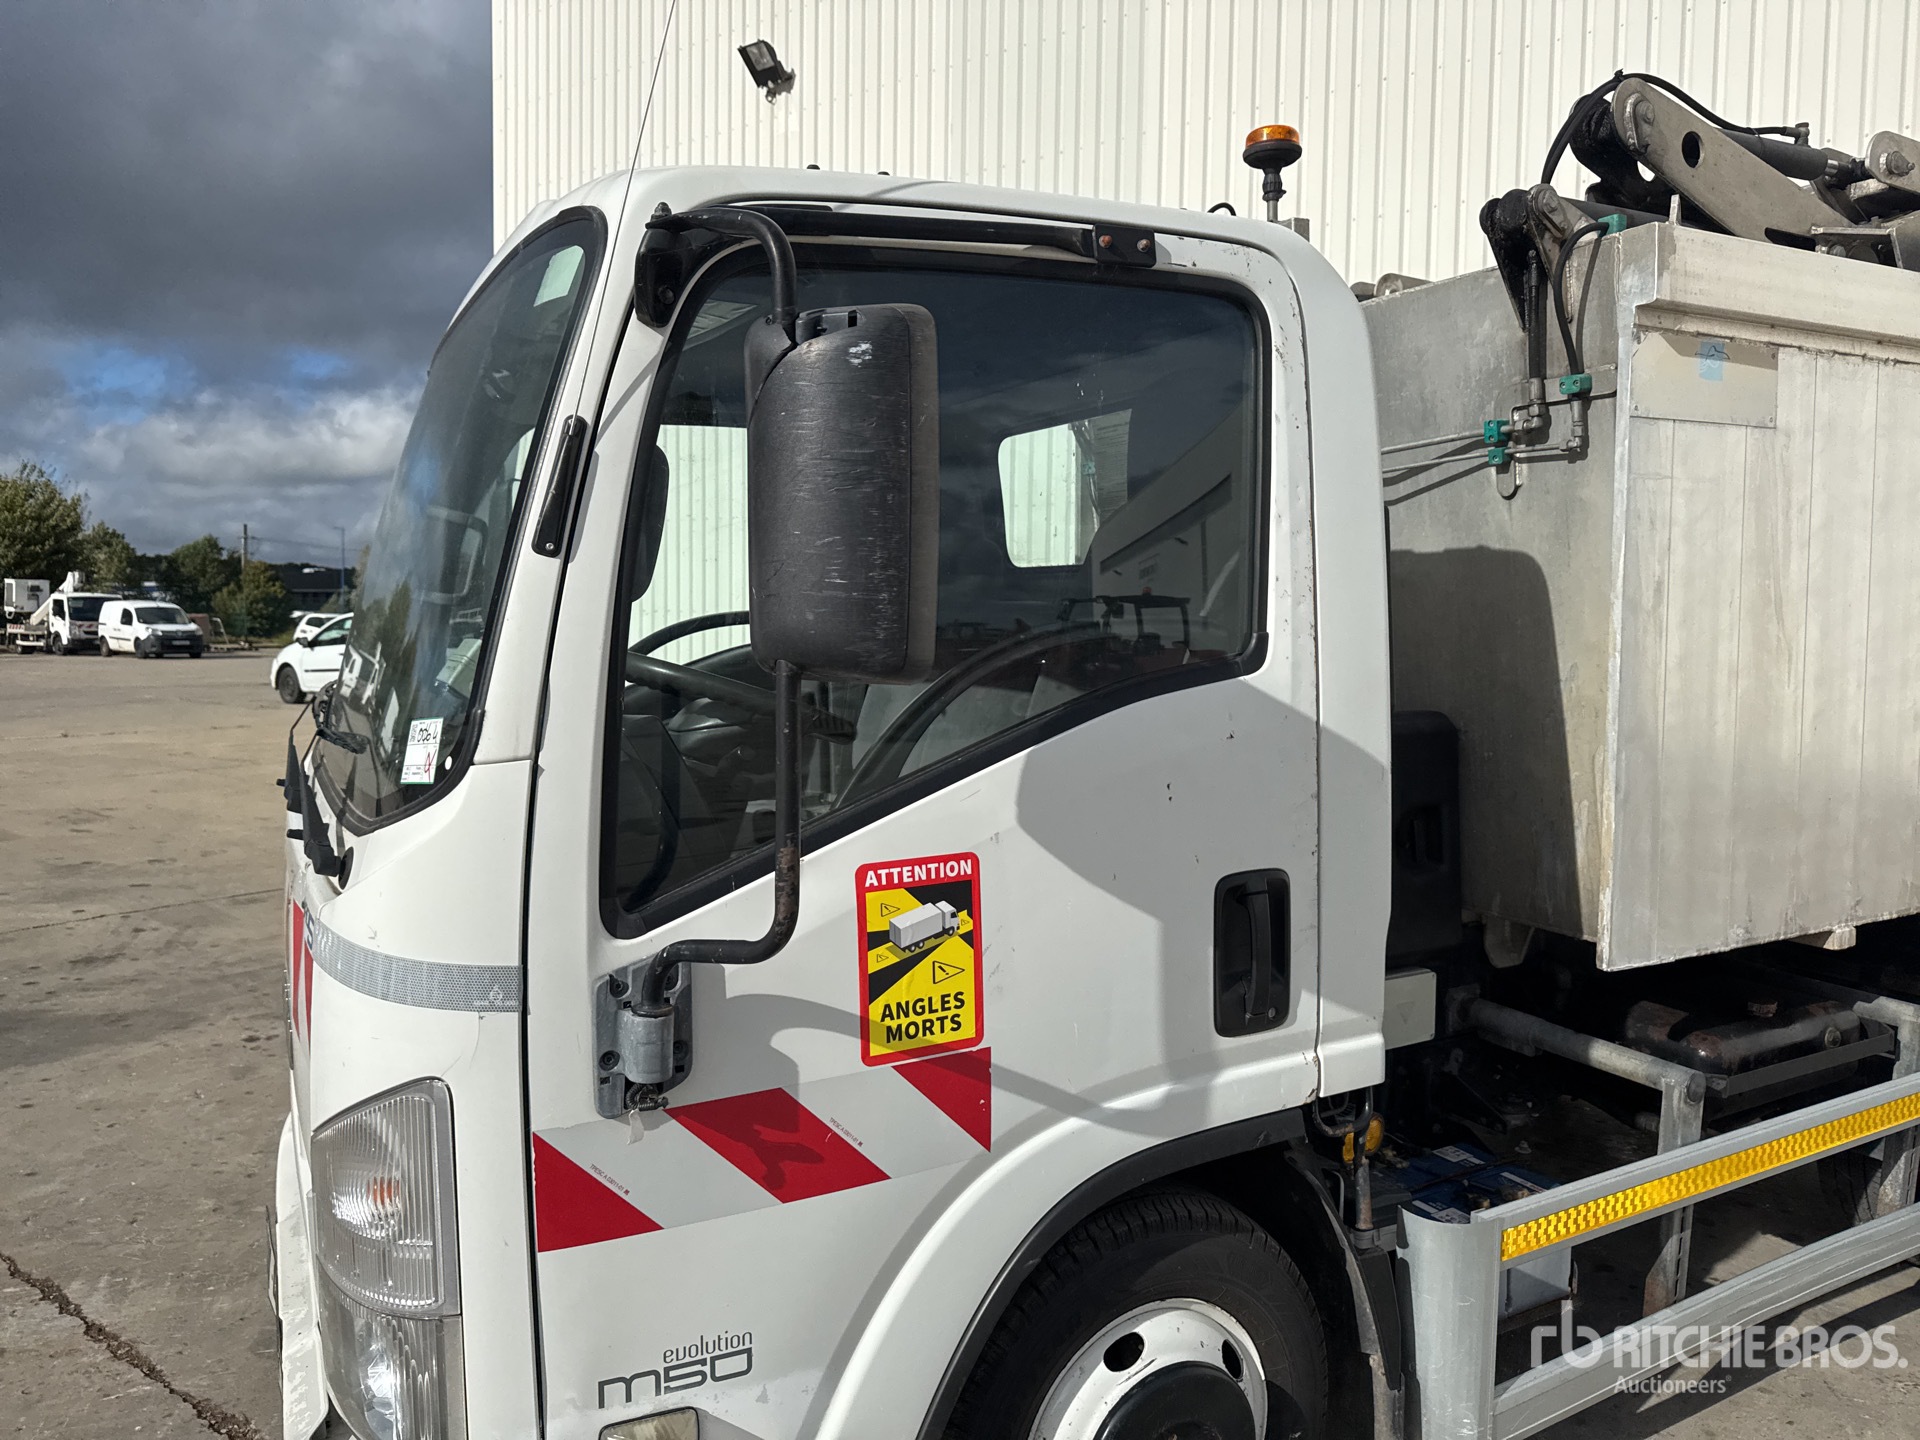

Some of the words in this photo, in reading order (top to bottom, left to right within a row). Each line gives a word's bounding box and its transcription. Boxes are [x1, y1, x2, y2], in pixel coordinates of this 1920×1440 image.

[864, 858, 973, 888] ATTENTION
[880, 991, 966, 1023] ANGLES
[886, 1013, 962, 1044] MORTS
[663, 1330, 753, 1364] evolution
